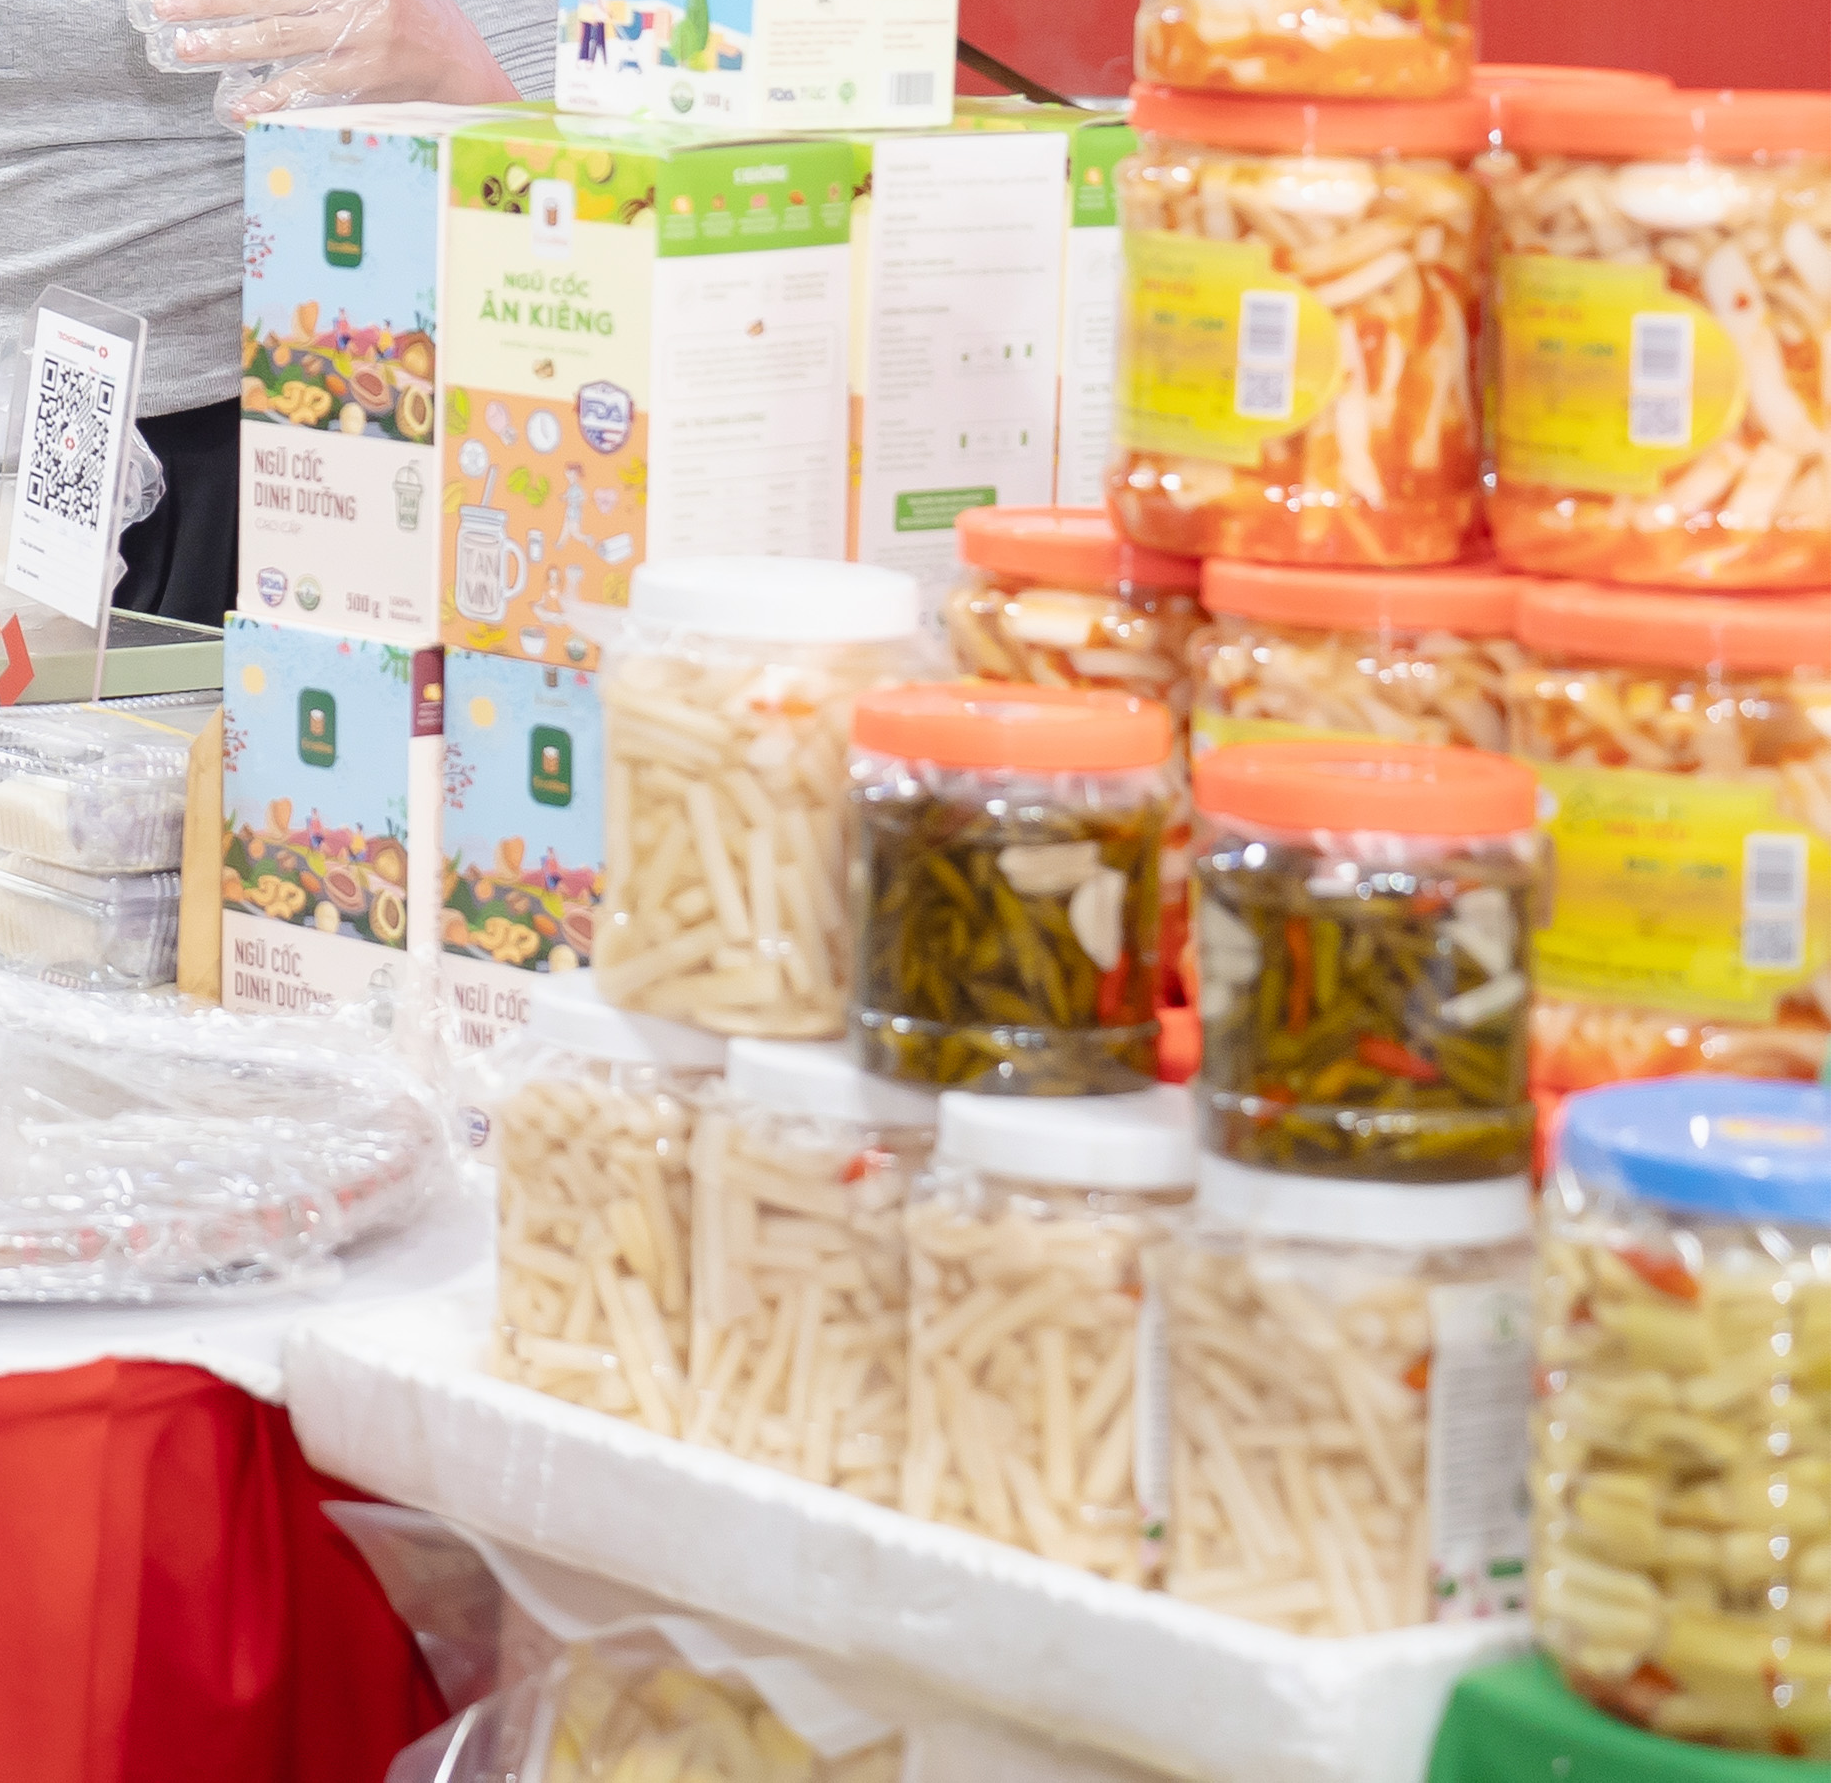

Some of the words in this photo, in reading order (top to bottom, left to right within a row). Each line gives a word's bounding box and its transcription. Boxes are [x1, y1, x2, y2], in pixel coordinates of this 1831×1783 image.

[479, 290, 521, 324] ĂN
[529, 300, 614, 336] KIÊNG
[584, 400, 624, 422] FDA
[253, 446, 287, 479] NGŨ
[292, 447, 325, 482] CỐC
[253, 481, 291, 512] DINH
[297, 487, 357, 522] DƯỠNG
[234, 937, 265, 969] NGŨ
[271, 943, 303, 978] CỐC
[234, 971, 271, 1004] DINH
[454, 983, 489, 1014] NGŨ
[494, 988, 531, 1024] CỐC
[454, 1019, 495, 1048] INH
